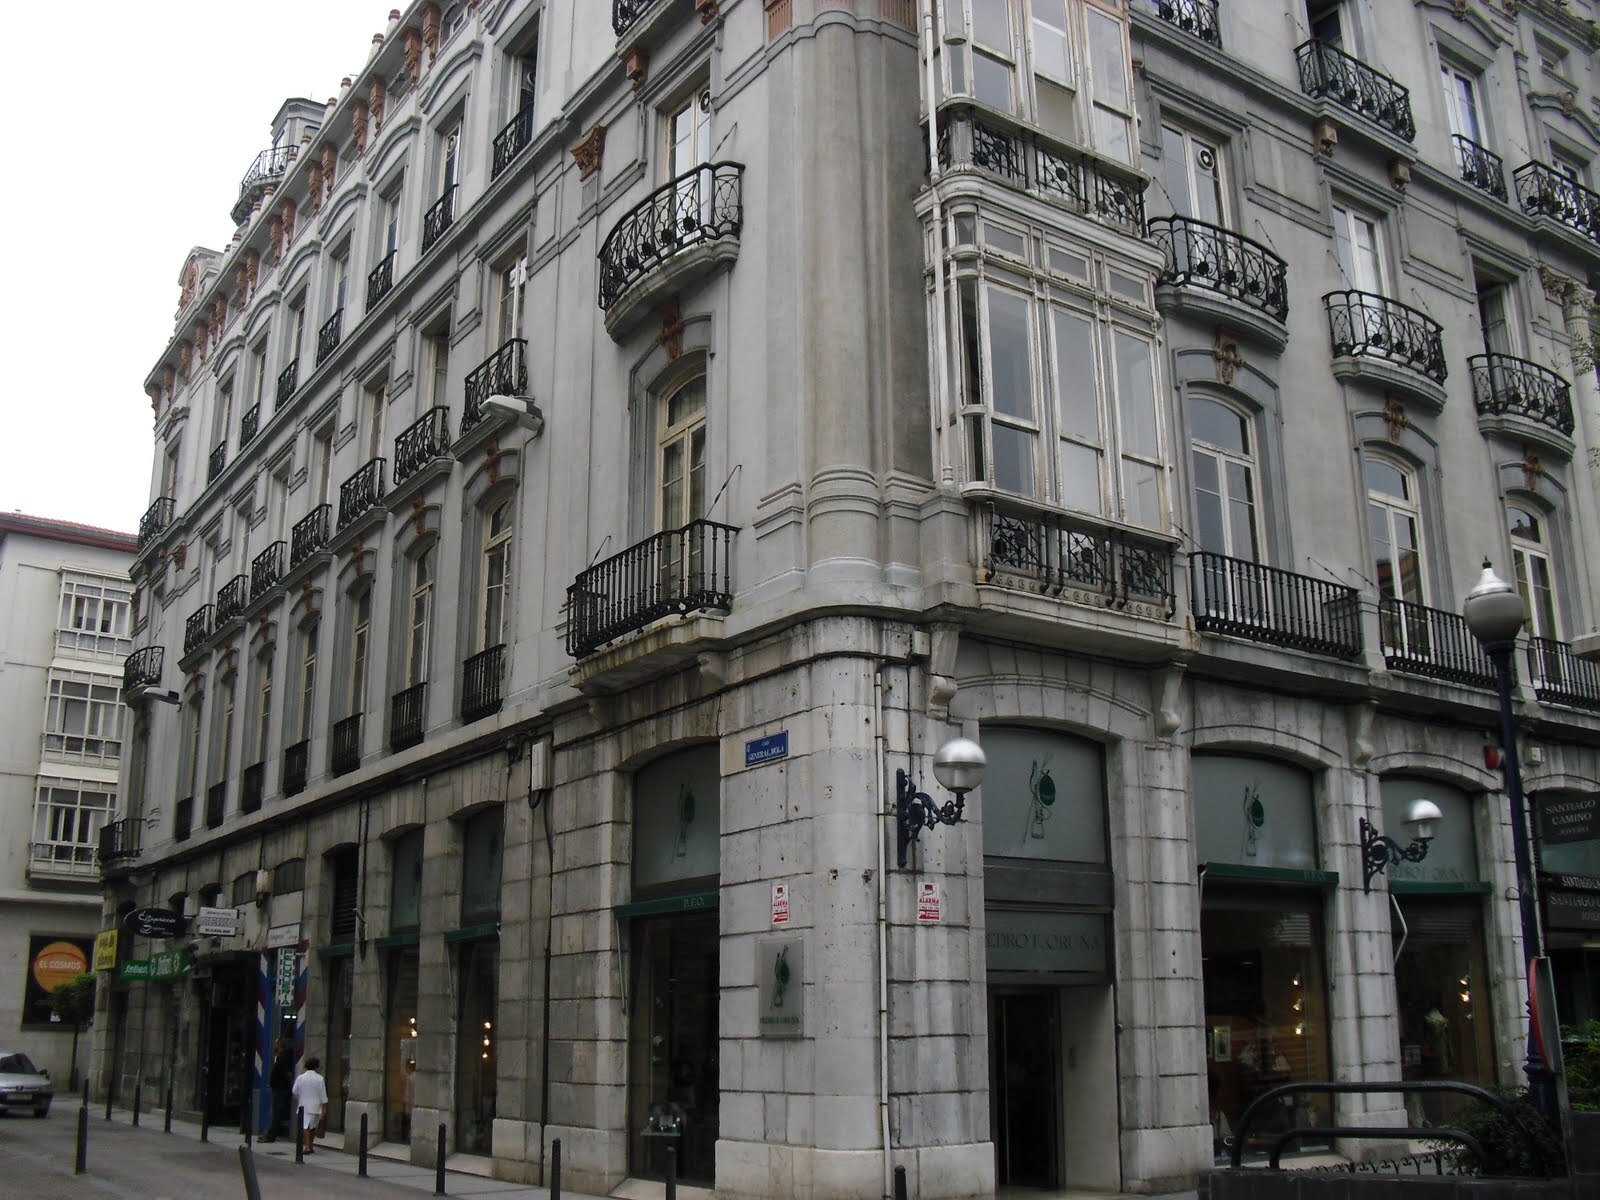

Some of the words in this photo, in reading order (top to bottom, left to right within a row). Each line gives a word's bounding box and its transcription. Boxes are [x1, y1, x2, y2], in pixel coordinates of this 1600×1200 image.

[1545, 800, 1596, 815] SANTIAGO
[1551, 811, 1592, 825] CAMINO
[1562, 875, 1592, 888] SANTIAGO
[49, 960, 81, 970] COSMOS
